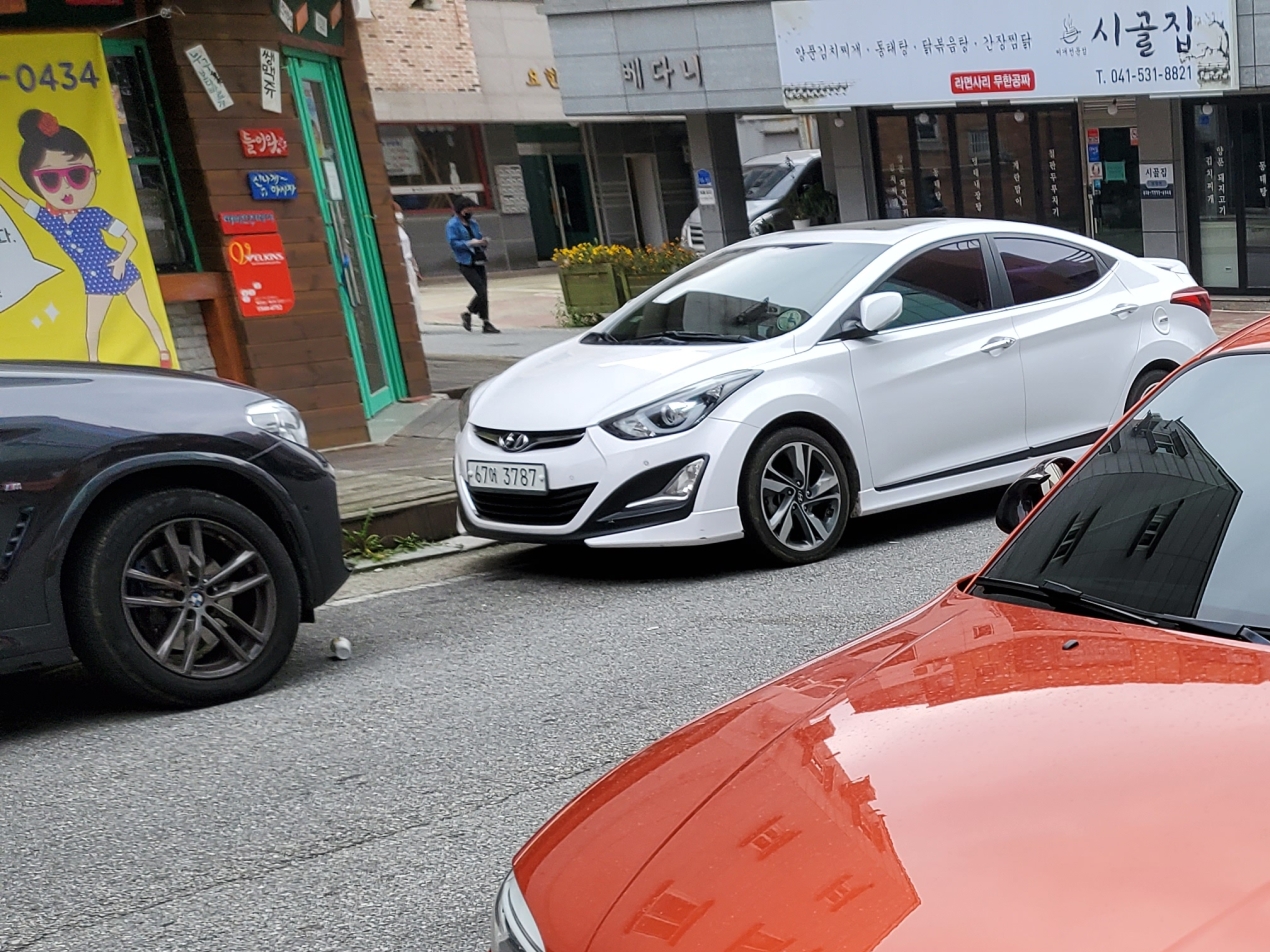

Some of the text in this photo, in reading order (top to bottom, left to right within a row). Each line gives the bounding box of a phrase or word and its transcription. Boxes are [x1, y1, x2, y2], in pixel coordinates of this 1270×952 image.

[795, 31, 1033, 61] 양푼김치찌개 동태탕 닭볶음탕 간장찜닭
[1091, 5, 1194, 57] 시골집
[622, 54, 704, 91] 베다니
[954, 72, 1032, 91] 라면사리 무한공짜
[1096, 66, 1193, 85] T. 041-531-8821
[1217, 173, 1226, 216] 돼지고기
[1258, 161, 1268, 197] 동태탕
[503, 467, 537, 487] 3787
